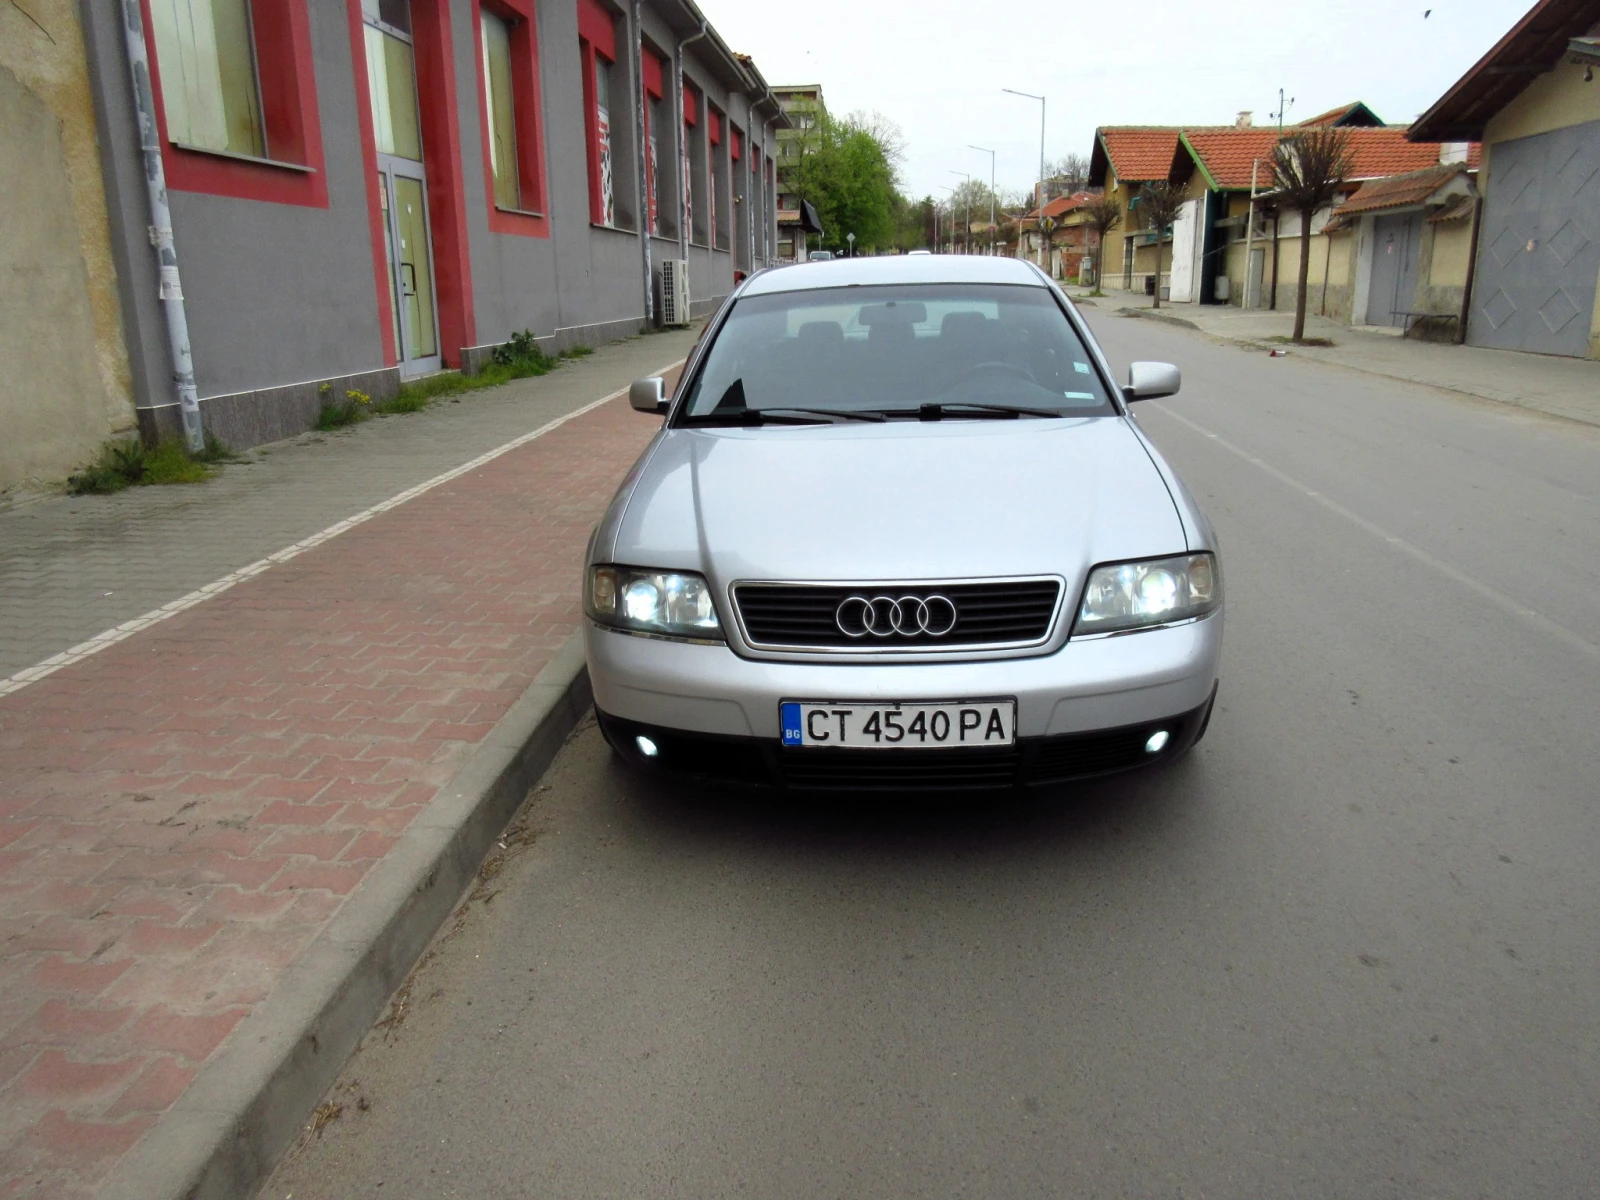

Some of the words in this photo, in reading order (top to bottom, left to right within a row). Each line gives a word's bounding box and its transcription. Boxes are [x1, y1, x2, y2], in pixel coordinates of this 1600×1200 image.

[785, 729, 800, 739] BG
[807, 709, 852, 742] CT
[862, 710, 950, 742] 4540
[959, 707, 1005, 741] PA
